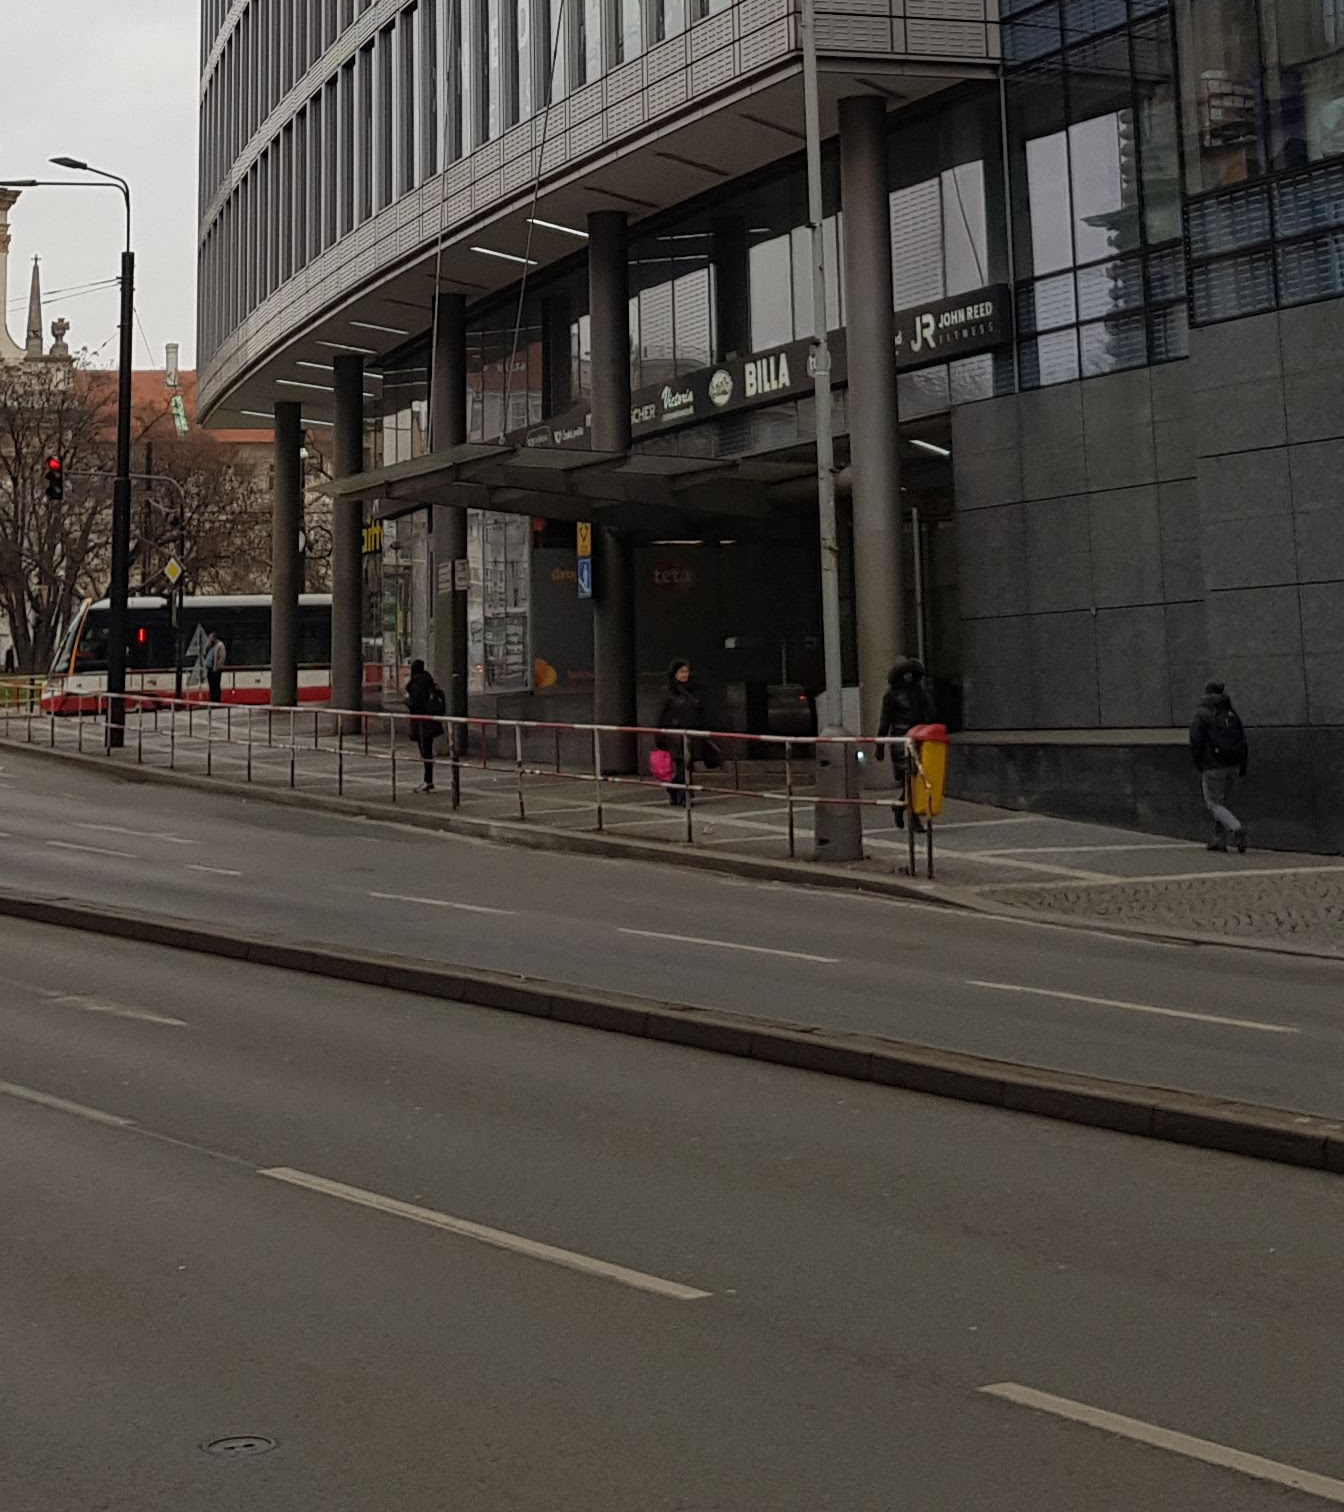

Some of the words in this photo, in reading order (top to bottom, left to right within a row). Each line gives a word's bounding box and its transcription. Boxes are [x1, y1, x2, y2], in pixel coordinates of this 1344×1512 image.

[937, 307, 966, 329] JOHN
[966, 301, 993, 321] REED
[909, 313, 937, 353] JR
[938, 322, 993, 345] FITNESS
[744, 352, 791, 398] BILLA
